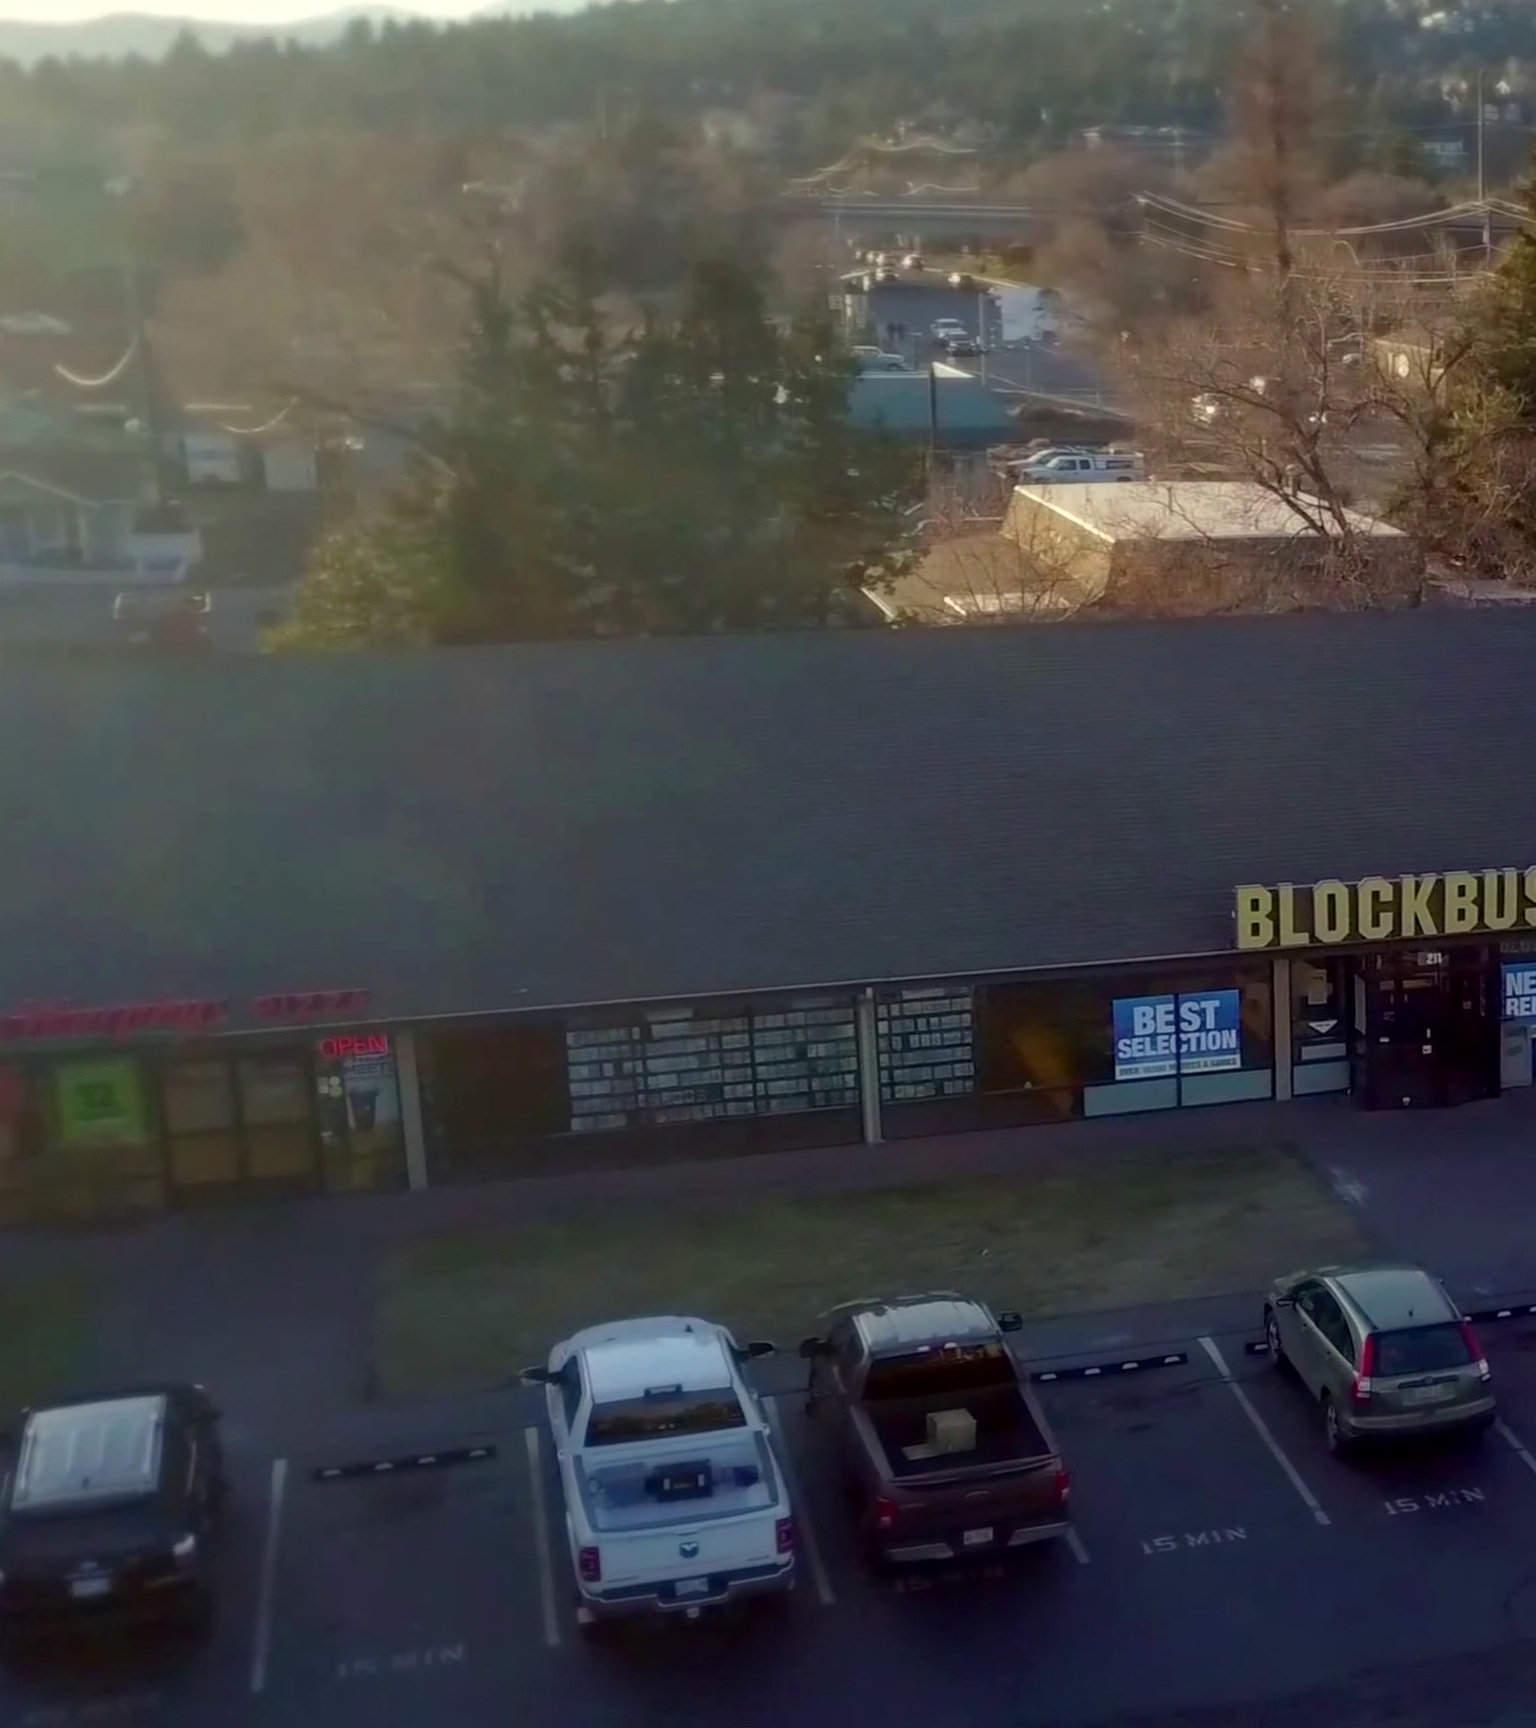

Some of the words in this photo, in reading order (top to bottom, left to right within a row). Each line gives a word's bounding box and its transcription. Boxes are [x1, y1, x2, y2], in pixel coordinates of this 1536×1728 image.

[1133, 999, 1220, 1036] BEST
[320, 1034, 388, 1058] OPEN
[1117, 1029, 1238, 1059] SELECTION
[1385, 1498, 1420, 1515] 15
[1424, 1487, 1486, 1507] MIN
[1142, 1536, 1177, 1554] 15
[1185, 1527, 1247, 1547] MIN
